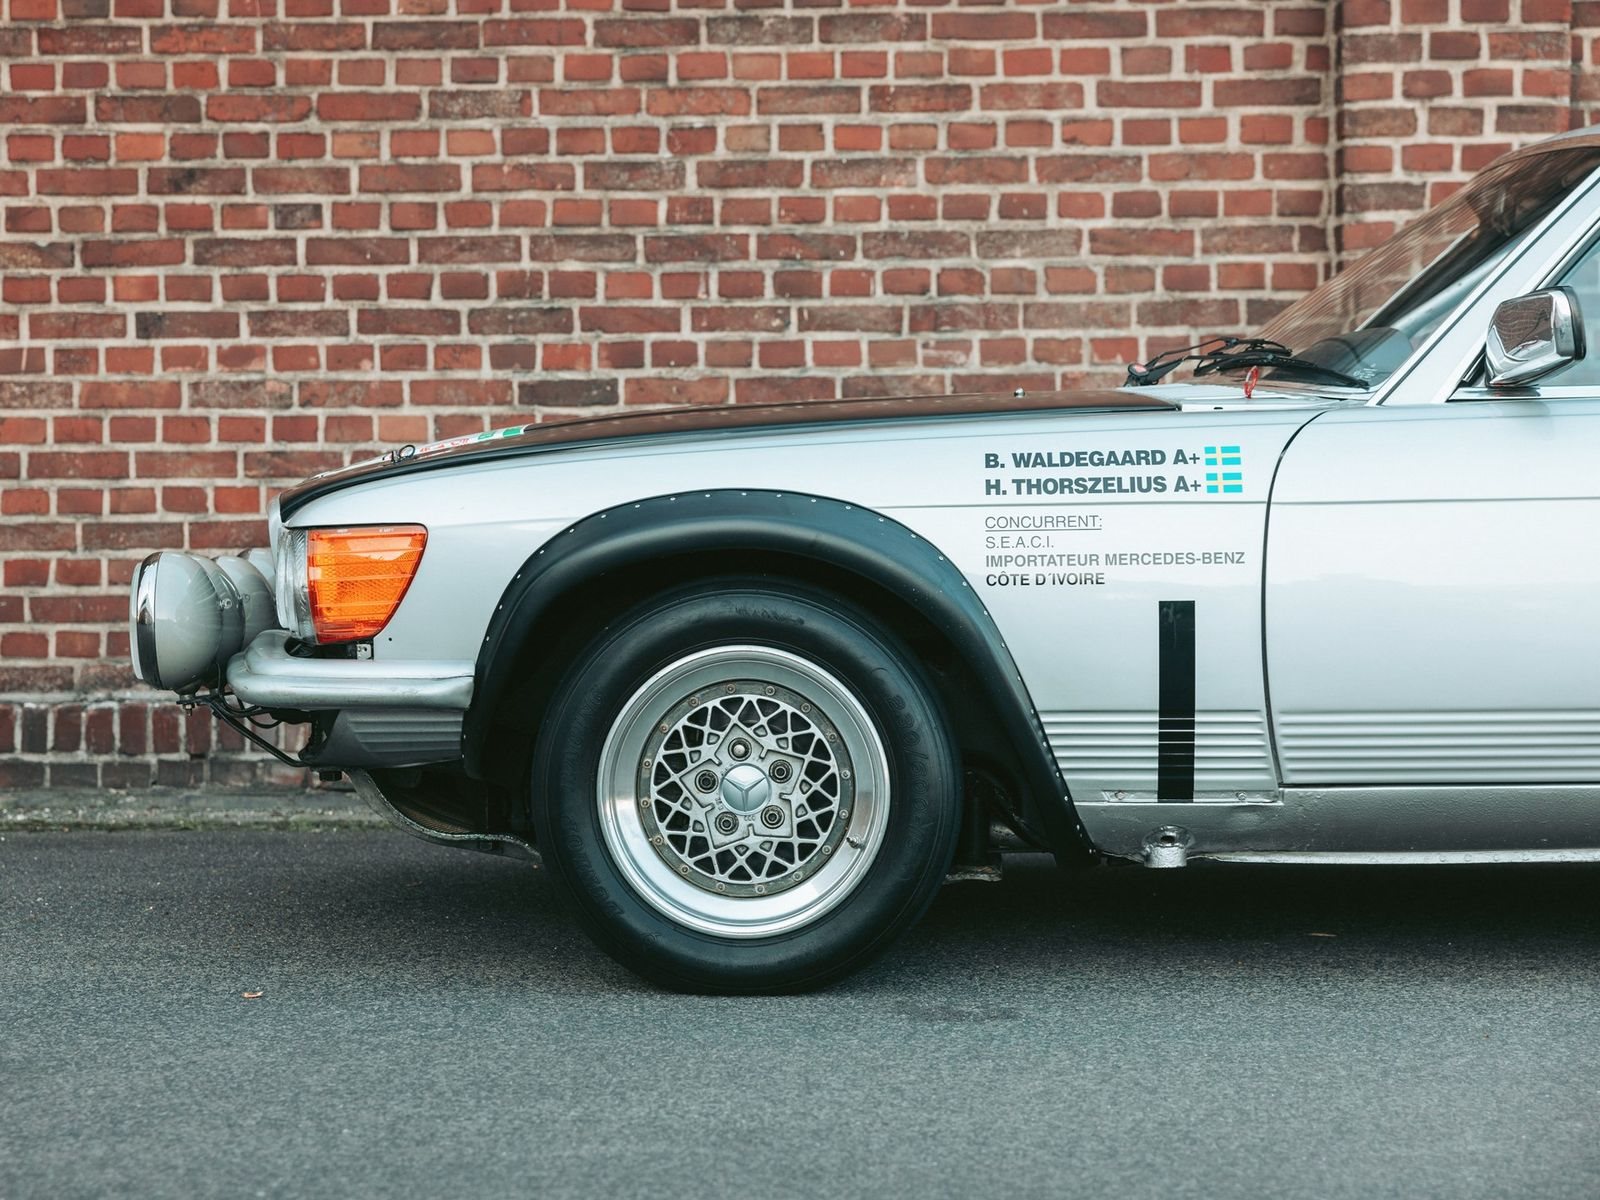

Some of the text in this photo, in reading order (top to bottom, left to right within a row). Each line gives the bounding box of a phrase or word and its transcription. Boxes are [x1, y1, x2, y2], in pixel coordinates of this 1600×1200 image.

[985, 453, 1005, 469] B.
[1011, 449, 1167, 469] WALDEGAARD
[985, 479, 1007, 496] H.
[1011, 475, 1168, 496] THORSZELIUS
[985, 514, 1103, 530] CONCURRENT:
[985, 535, 1055, 549] S.E.A.C.I.
[985, 551, 1246, 568] IMPORTATEUR MERCEDES-BENZ
[985, 571, 1031, 587] CÔTE
